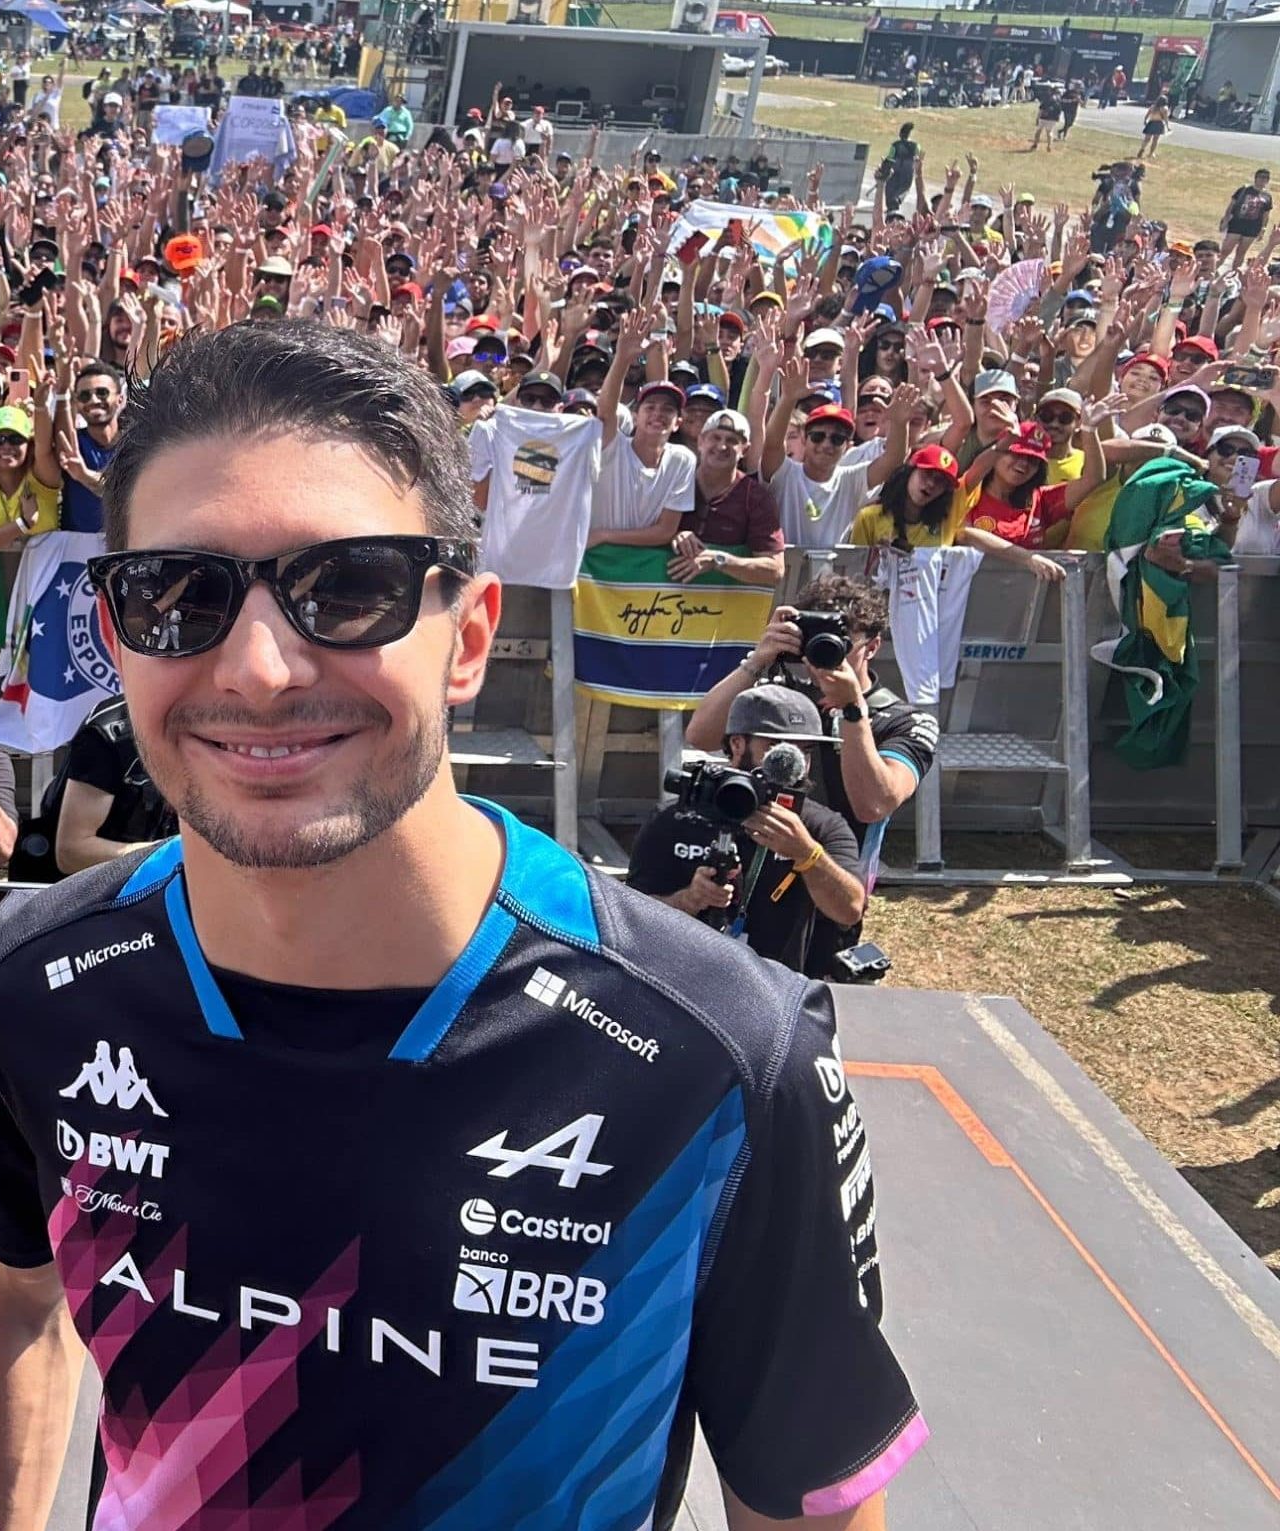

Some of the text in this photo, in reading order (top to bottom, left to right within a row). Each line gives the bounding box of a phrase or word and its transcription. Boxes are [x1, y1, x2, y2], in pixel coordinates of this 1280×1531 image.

[963, 644, 1027, 659] SERVICE
[74, 931, 156, 974] Microsoft
[562, 989, 661, 1063] Microsoft
[88, 1131, 170, 1179] BWT
[500, 1208, 612, 1246] Castrol
[459, 1245, 509, 1264] banco
[100, 1251, 539, 1389] ALPINE
[506, 1270, 607, 1326] BRB
